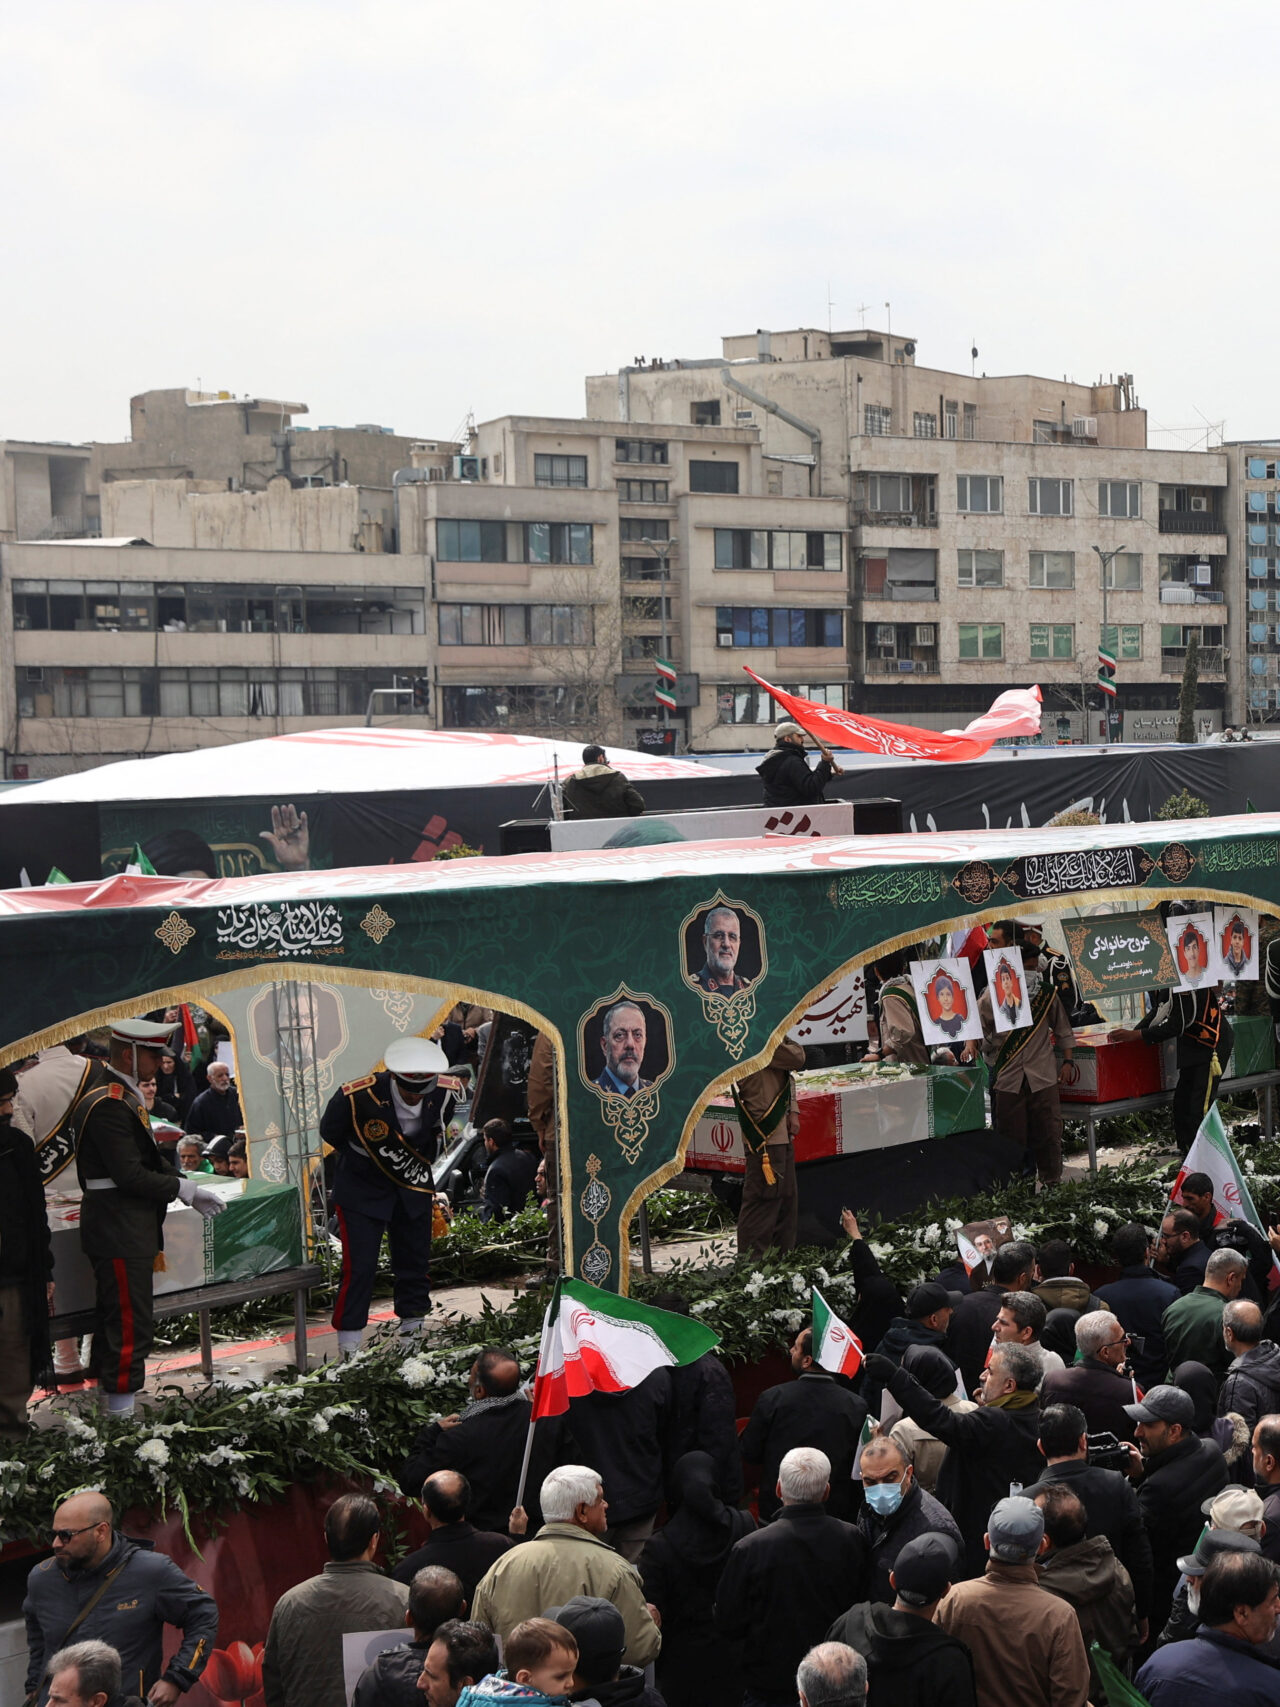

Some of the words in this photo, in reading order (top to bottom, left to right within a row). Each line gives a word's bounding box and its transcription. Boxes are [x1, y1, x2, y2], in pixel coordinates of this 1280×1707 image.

[1088, 934, 1128, 960] خانوادگی
[1128, 935, 1150, 953] عروج
[378, 1145, 414, 1170] ارتش
